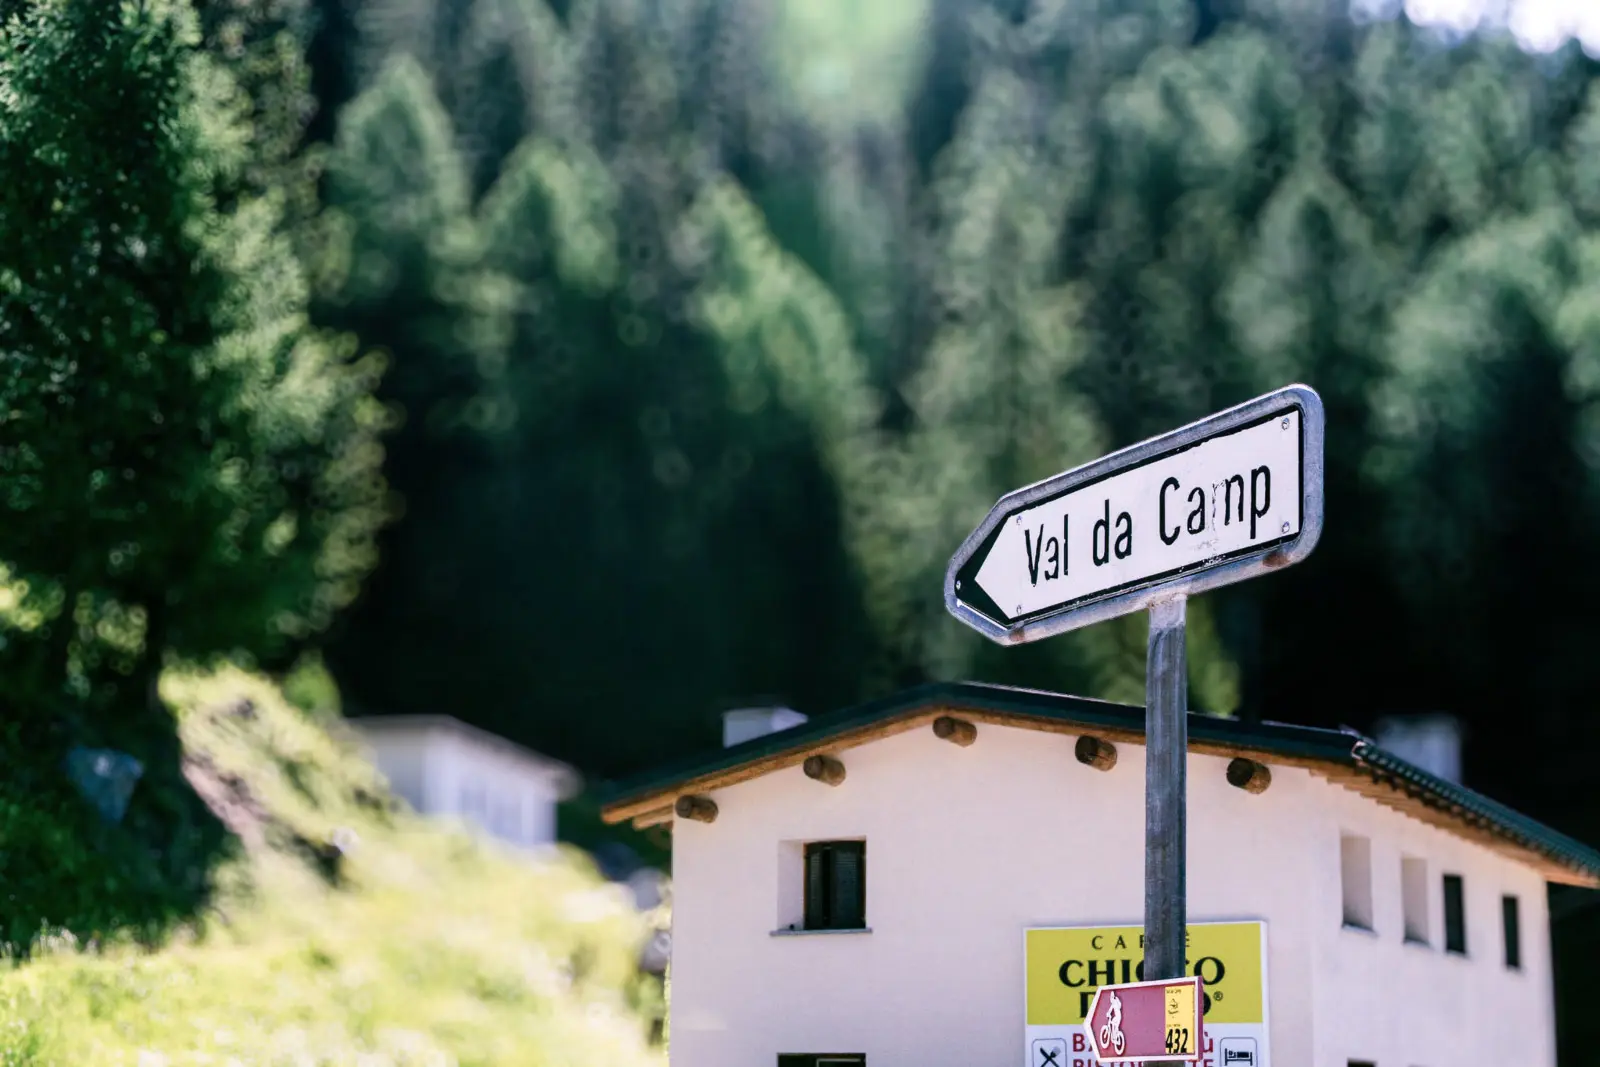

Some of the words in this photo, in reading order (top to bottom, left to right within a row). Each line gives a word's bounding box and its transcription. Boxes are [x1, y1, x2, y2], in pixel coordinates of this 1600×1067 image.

[1024, 514, 1069, 587] Val
[1092, 499, 1133, 566] da
[1158, 464, 1272, 546] Camp
[1058, 956, 1225, 988] CHIO
[1165, 1028, 1188, 1054] 432
